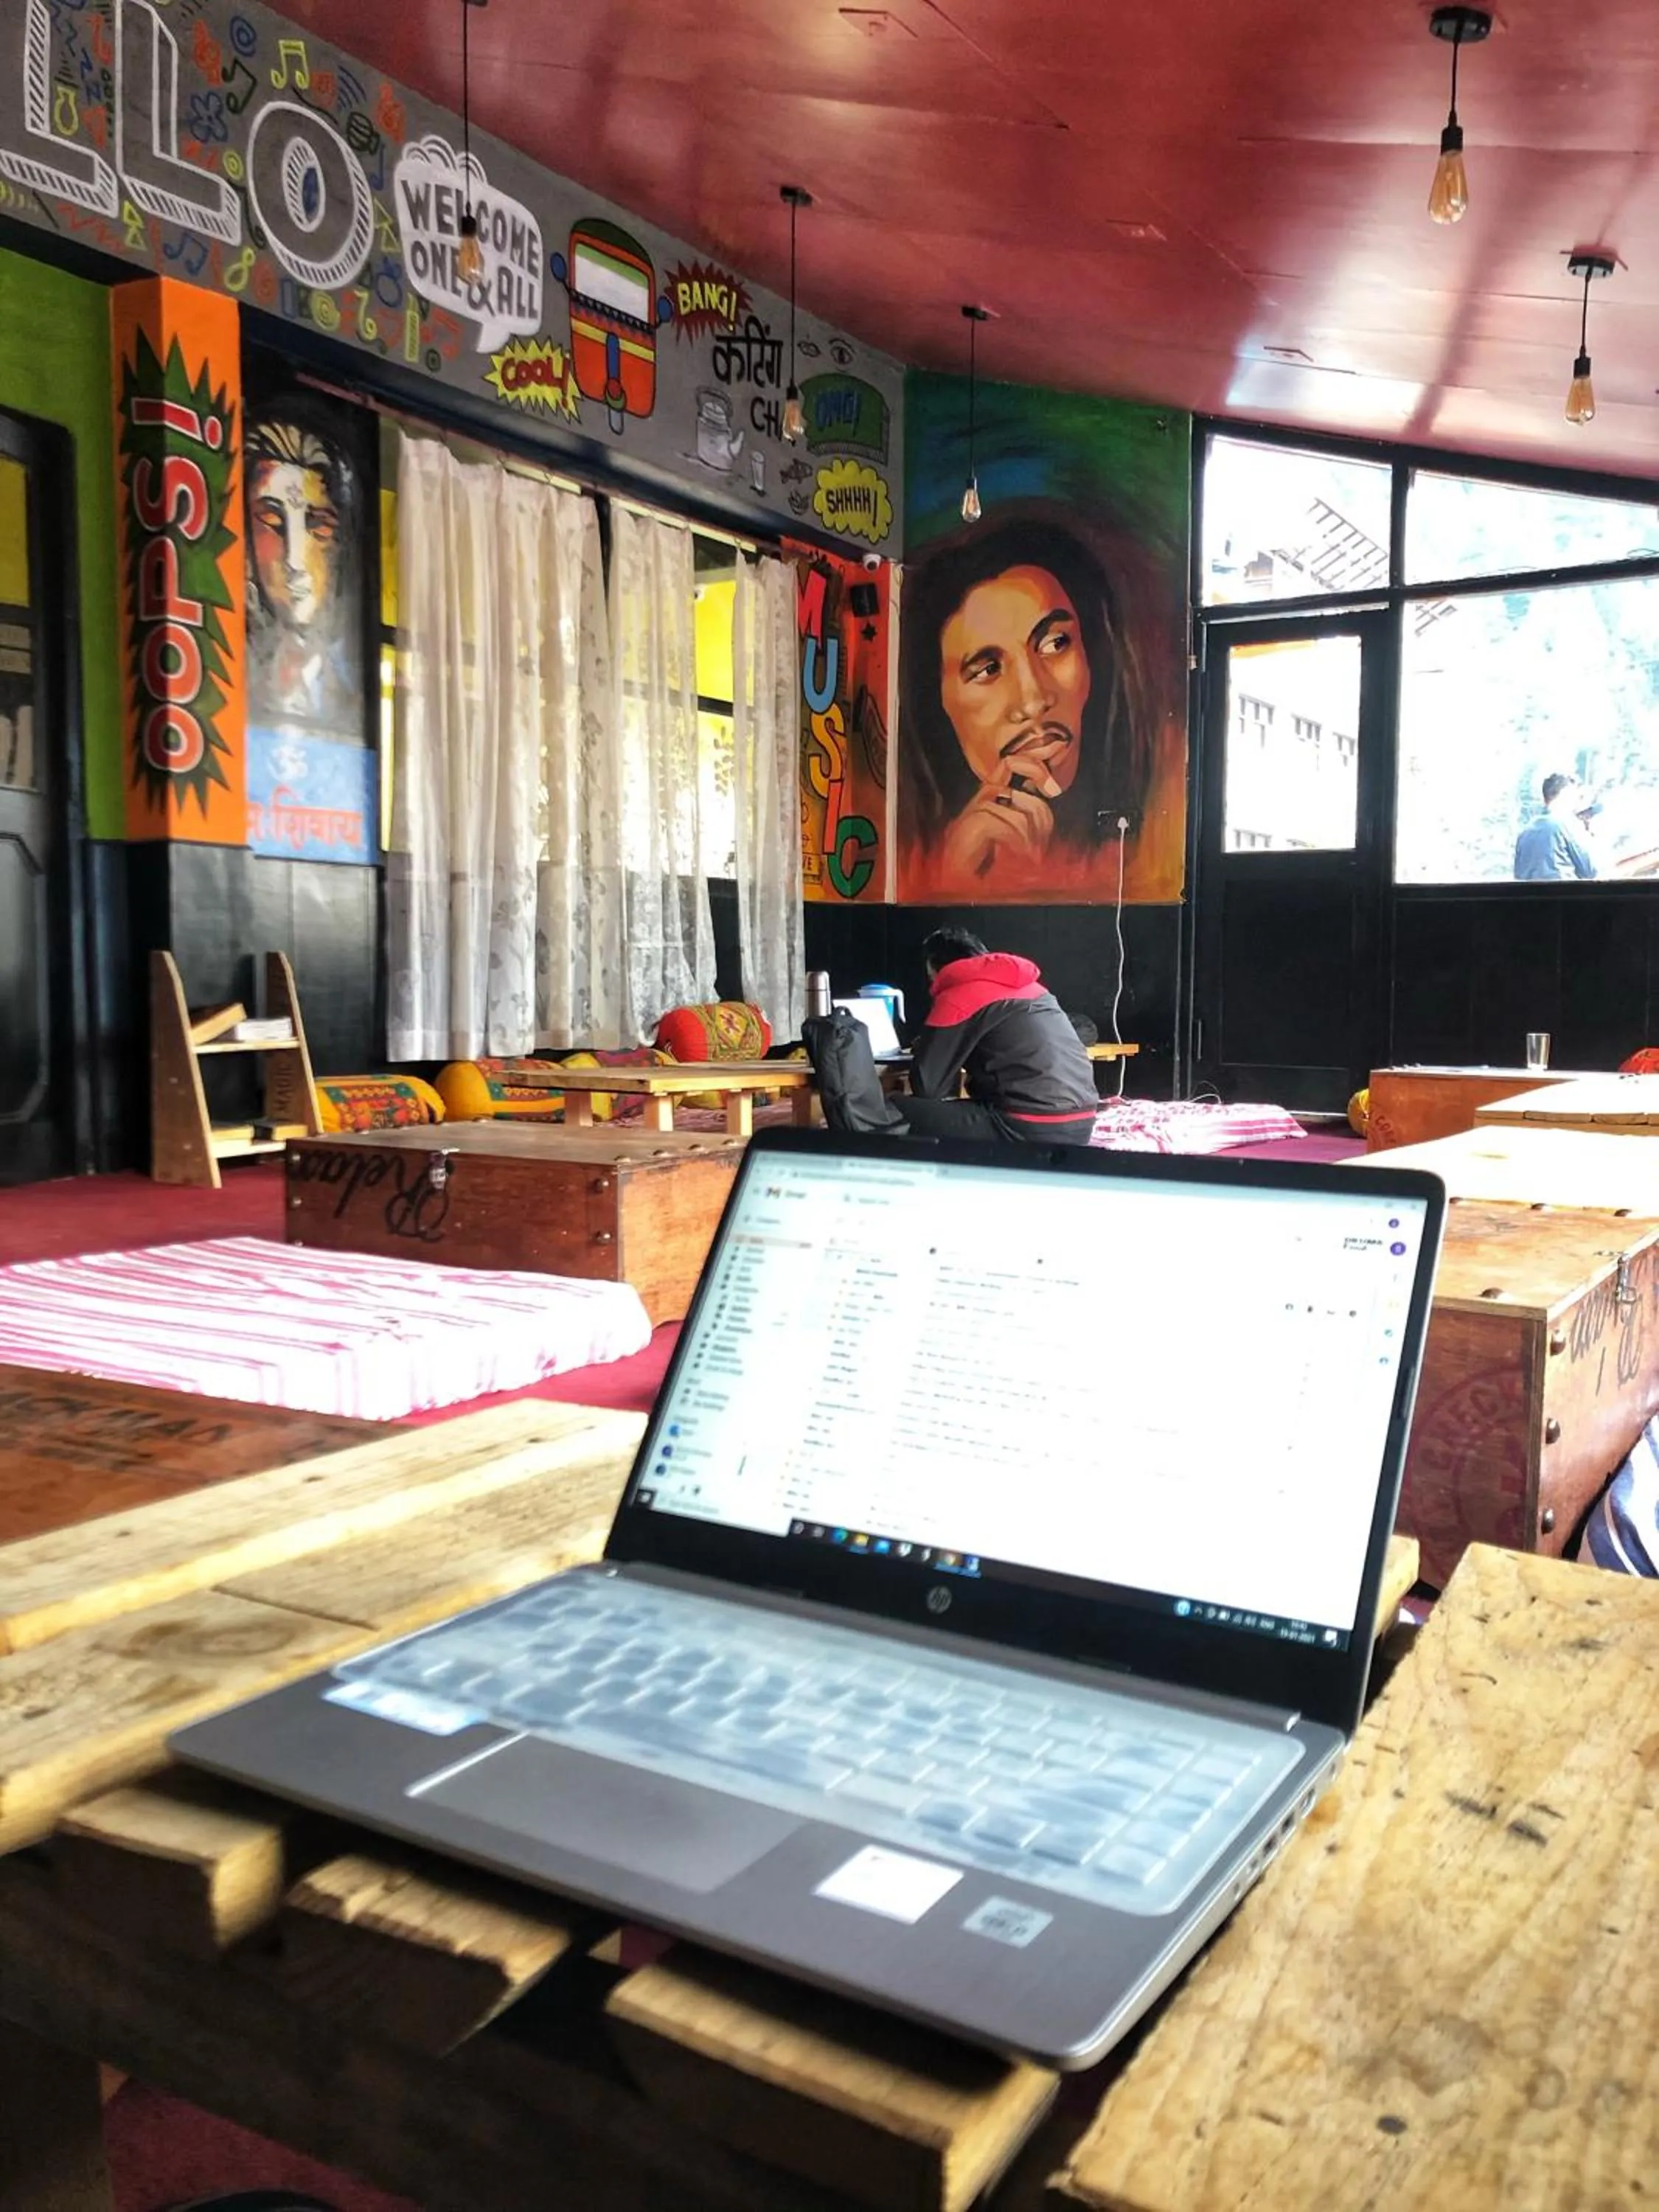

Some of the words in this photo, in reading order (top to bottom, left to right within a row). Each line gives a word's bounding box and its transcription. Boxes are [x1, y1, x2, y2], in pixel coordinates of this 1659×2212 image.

[401, 180, 540, 279] WELCOME
[411, 240, 462, 297] ONE
[498, 266, 539, 320] ALL
[678, 281, 737, 331] BANG!
[501, 353, 571, 408] COOL!
[712, 315, 784, 389] कटिंग
[826, 486, 878, 528] SHHHH!
[133, 397, 223, 773] OOPS!
[796, 566, 879, 899] MUSIC
